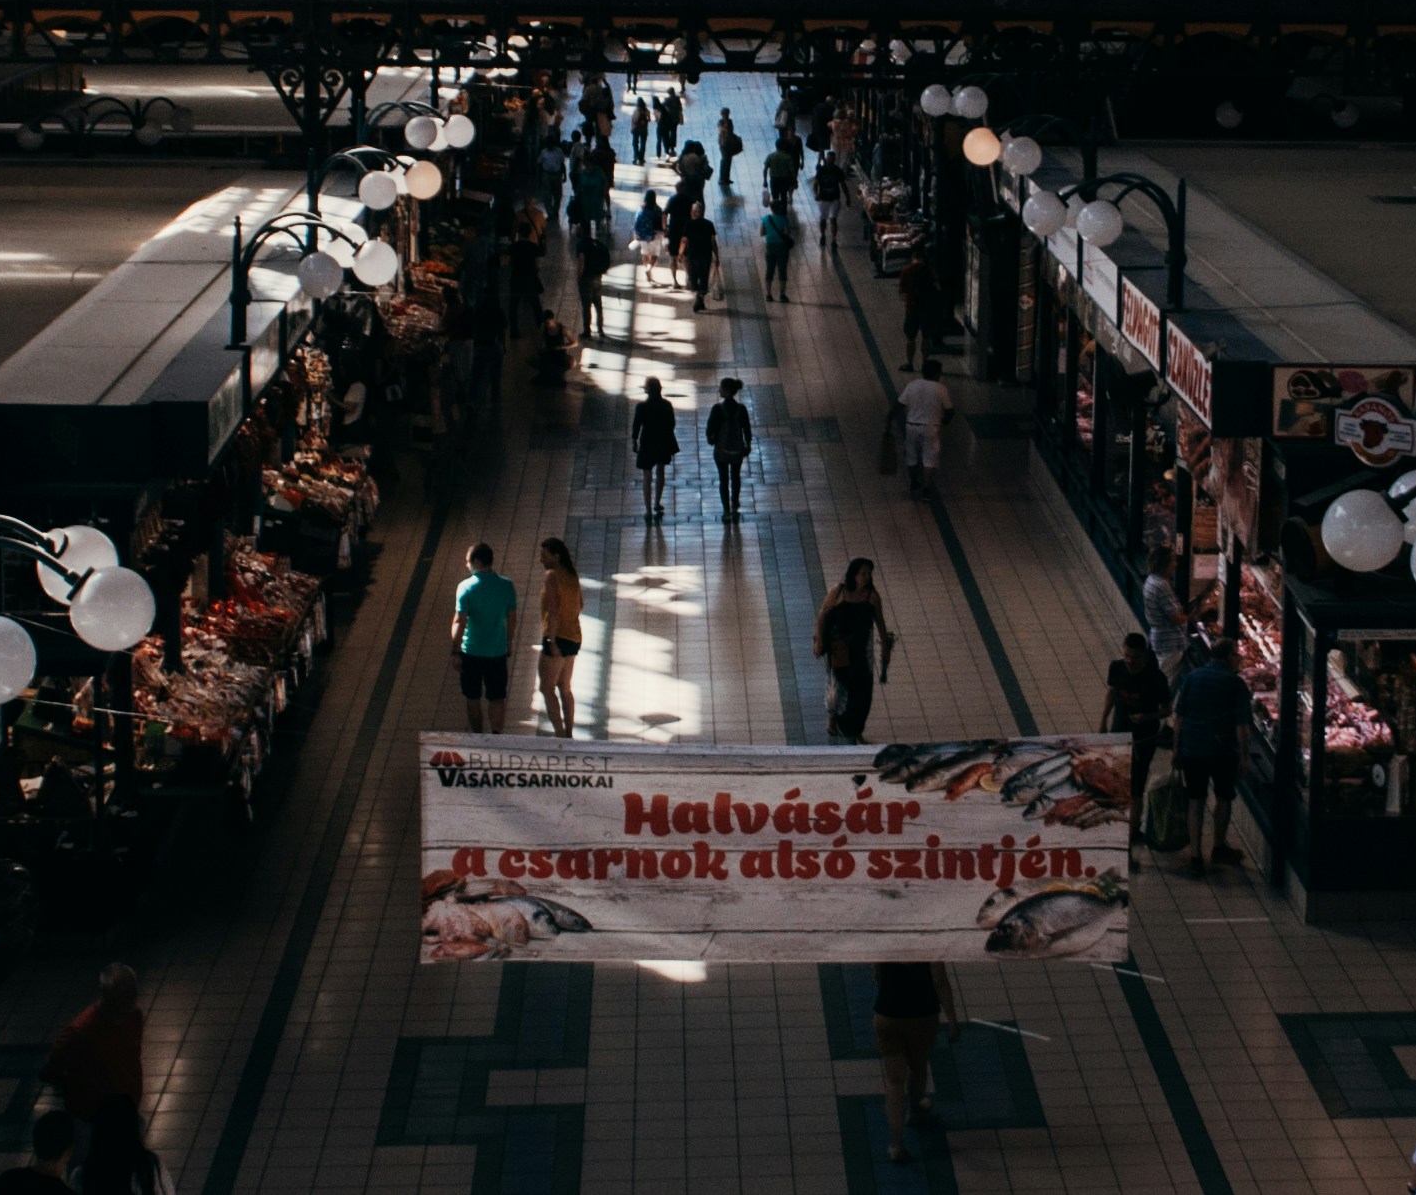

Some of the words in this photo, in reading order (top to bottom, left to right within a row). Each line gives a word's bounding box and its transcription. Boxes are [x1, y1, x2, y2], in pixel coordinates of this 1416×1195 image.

[438, 767, 614, 789] VÁSÁRCSARNOKAI
[468, 752, 614, 773] BUDAPEST
[622, 786, 921, 837] Halvásár
[451, 845, 487, 879] a
[498, 840, 728, 881] csarnok
[739, 834, 855, 880] alsó
[866, 834, 1097, 888] szintjén.
